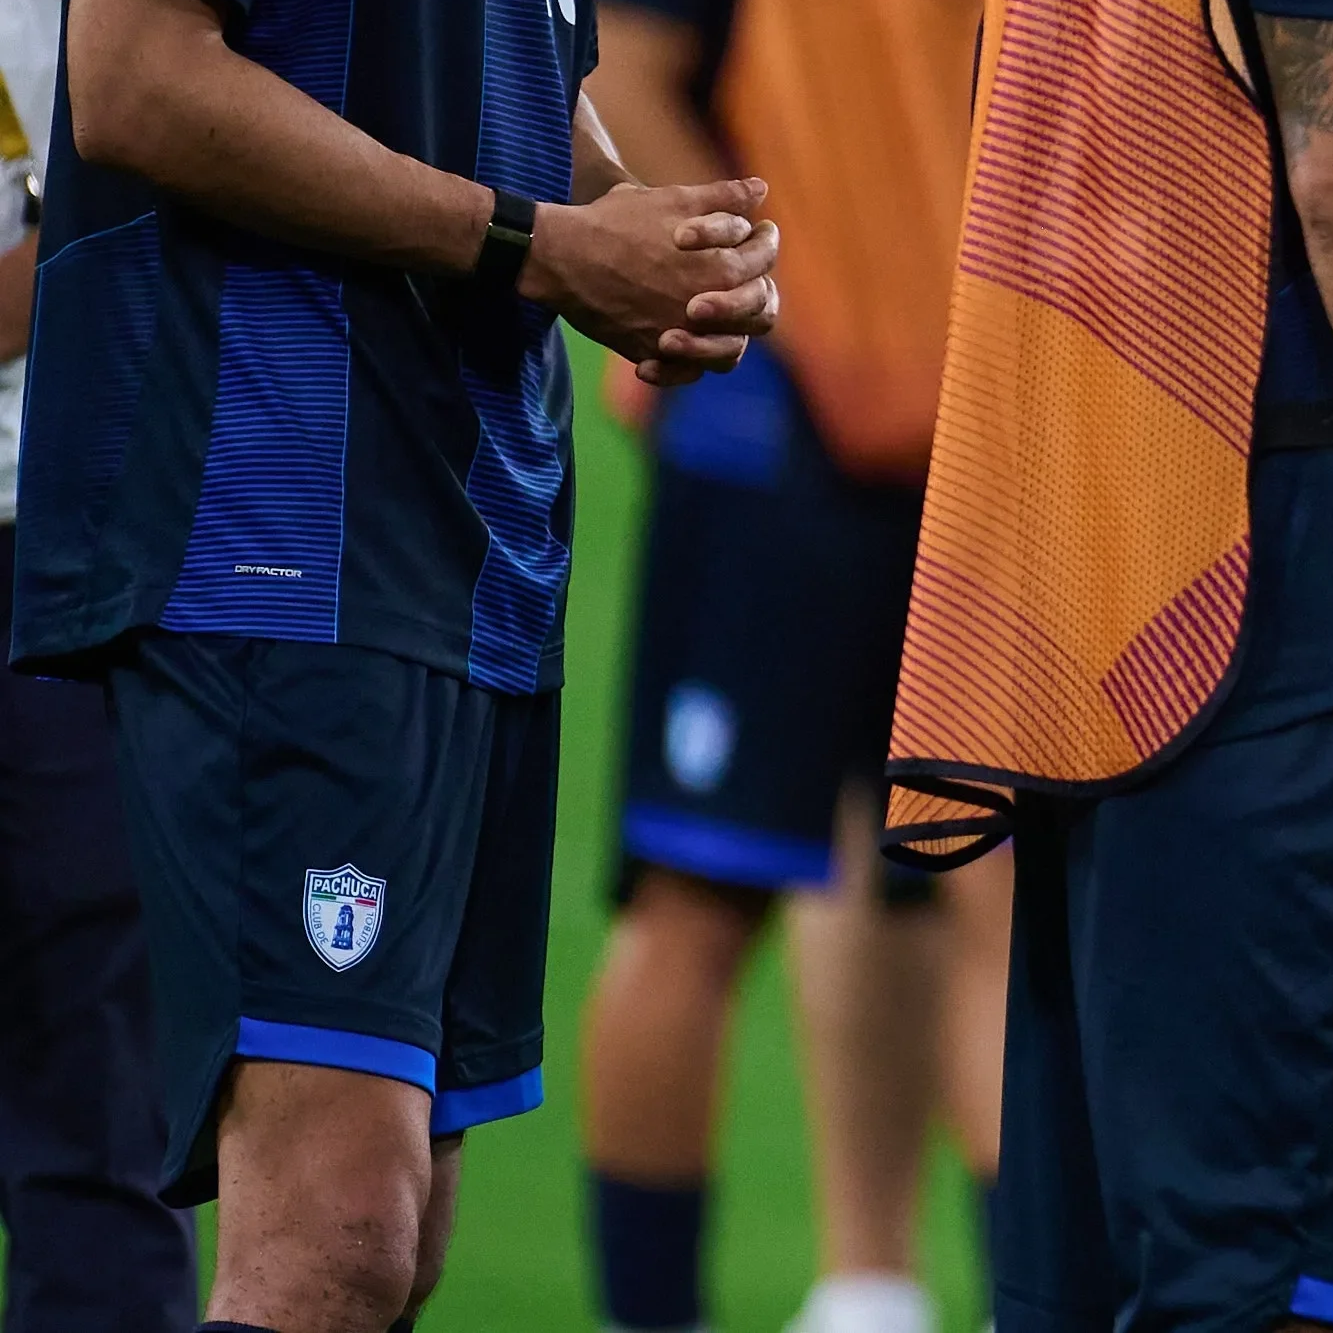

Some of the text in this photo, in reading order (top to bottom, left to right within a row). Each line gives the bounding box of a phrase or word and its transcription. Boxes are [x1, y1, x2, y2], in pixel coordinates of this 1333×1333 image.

[313, 876, 377, 899] PACHUCA
[312, 903, 329, 945] CLUB DE
[356, 911, 375, 947] FUTBOL
